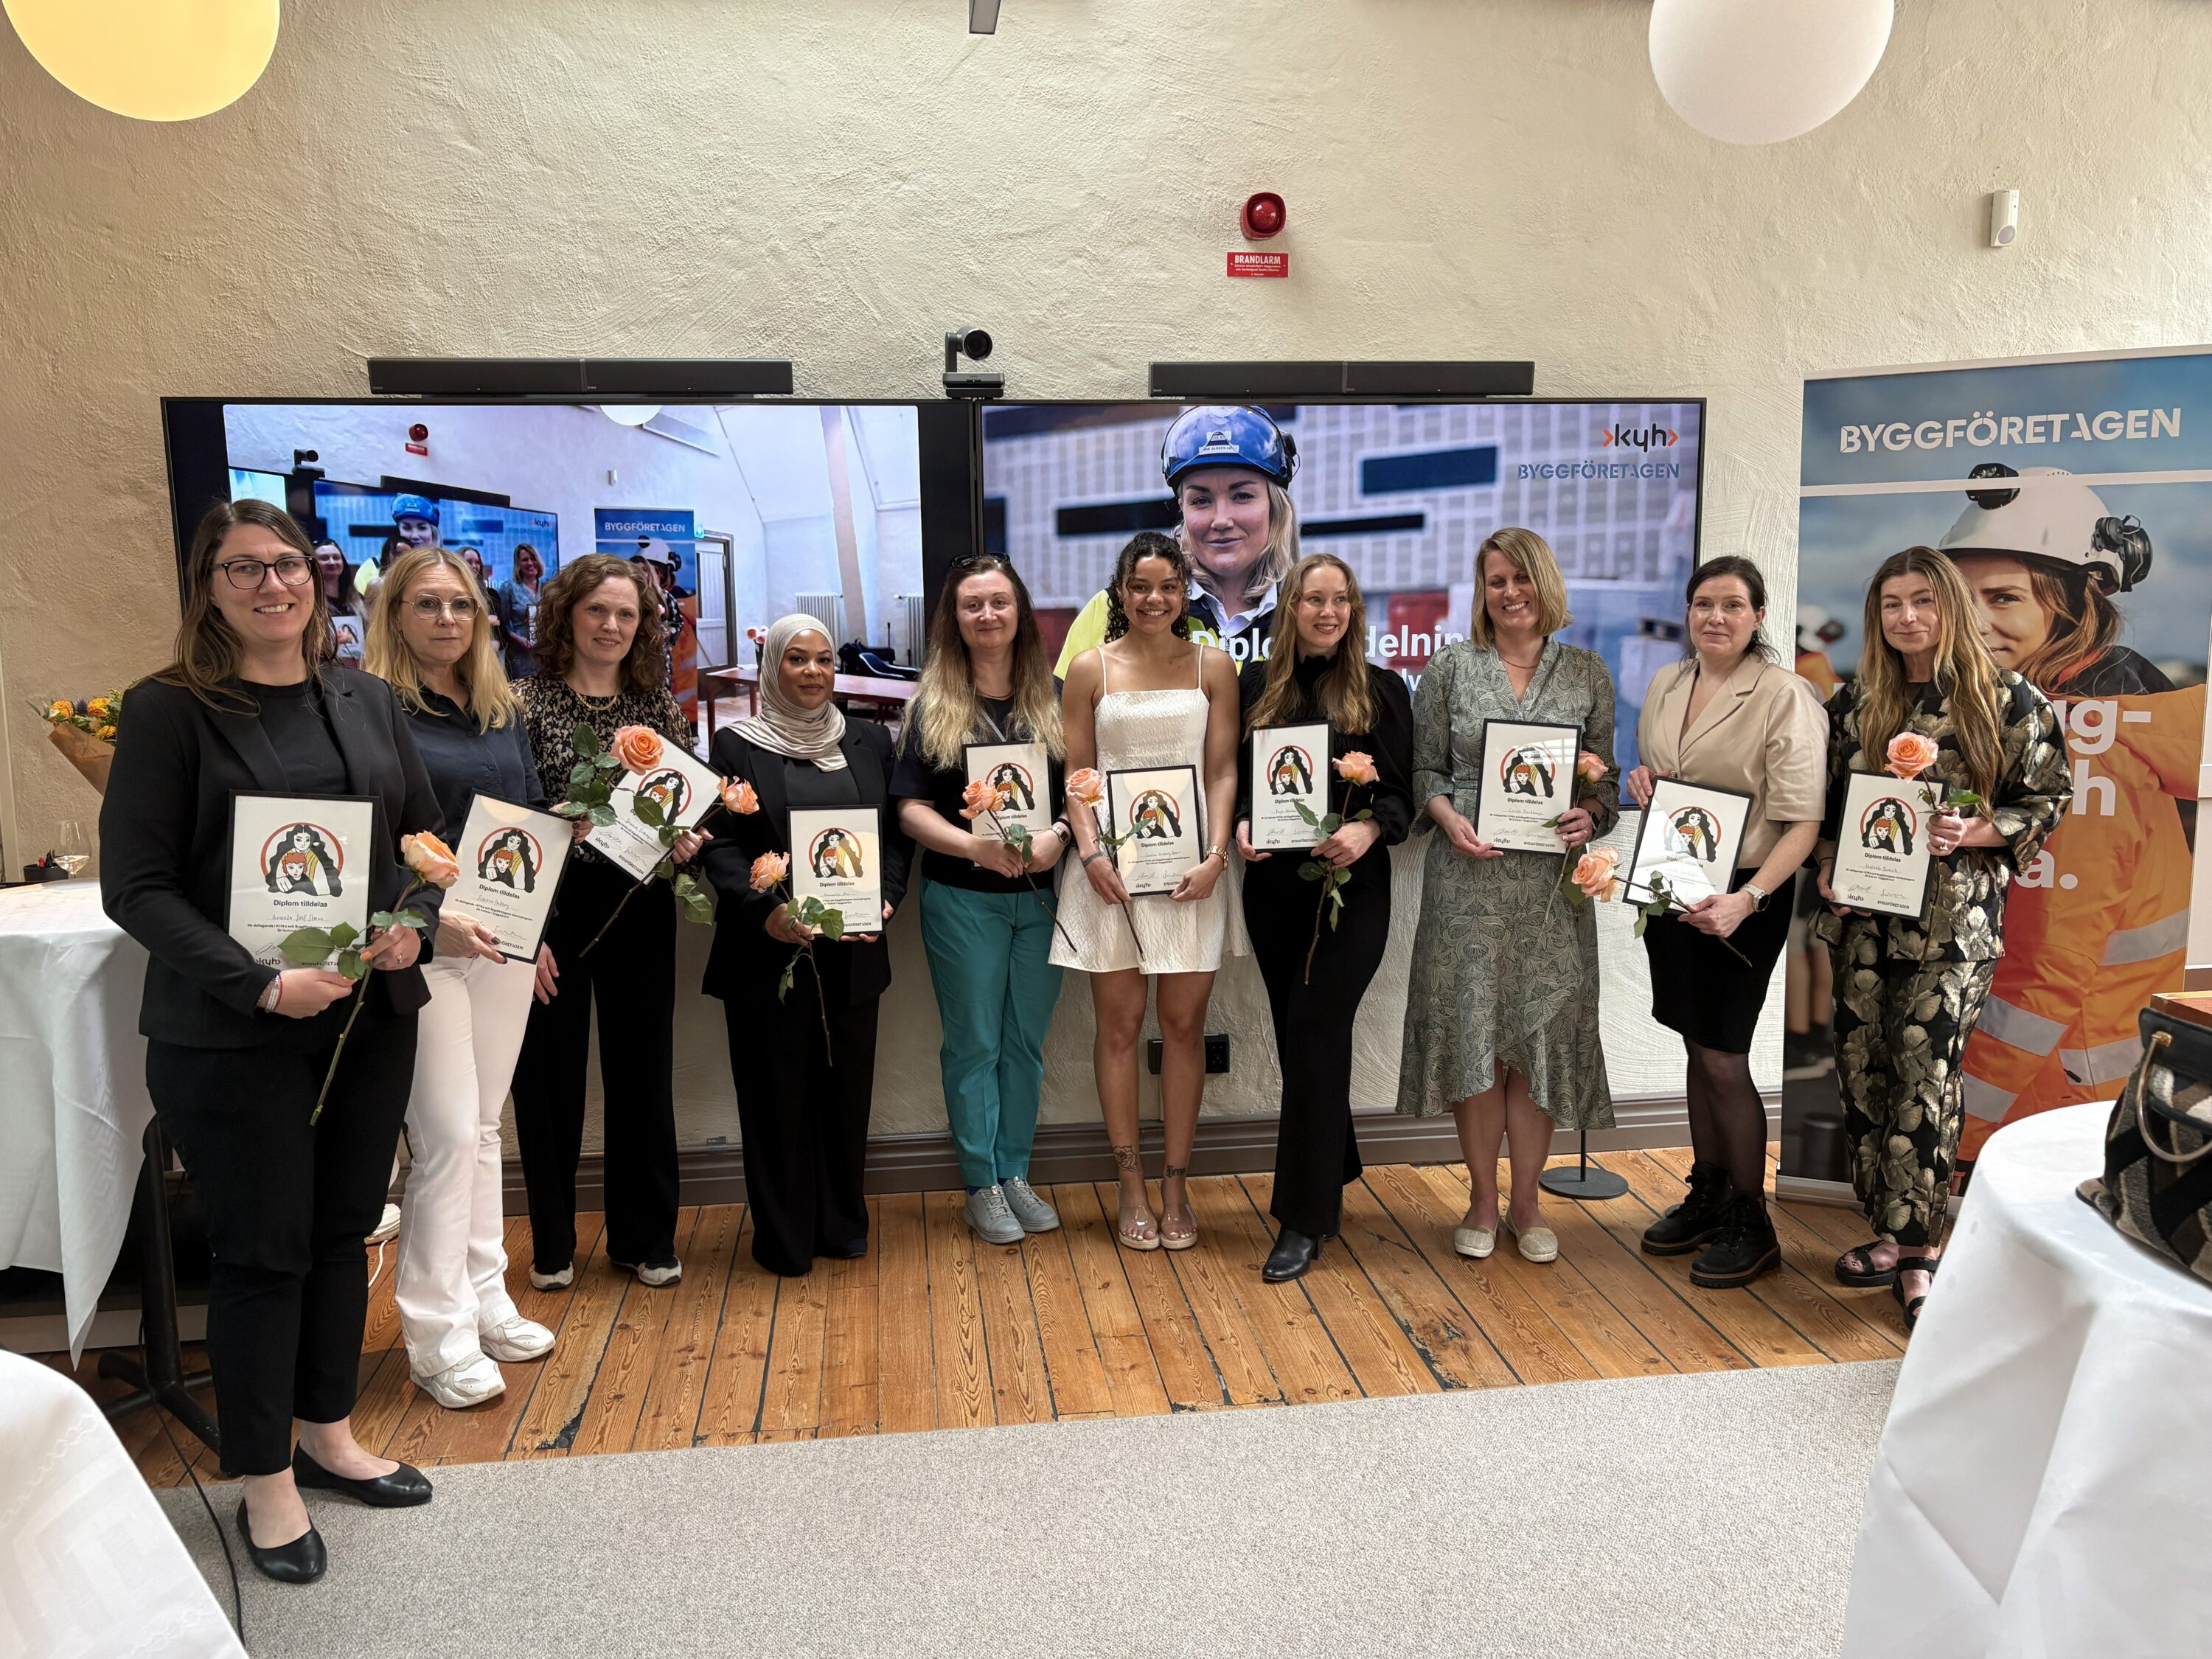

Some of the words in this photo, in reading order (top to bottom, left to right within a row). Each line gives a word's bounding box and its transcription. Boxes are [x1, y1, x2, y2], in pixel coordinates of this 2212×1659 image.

[1234, 254, 1281, 264] BRANDLARM
[1840, 408, 2181, 453] BYGGFÖRETAGEN
[1517, 460, 1680, 479] BYGGFÖRETAGEN
[605, 521, 686, 532] BYGGFÖRETAGEN
[479, 884, 499, 894] Diplom
[499, 889, 520, 900] tilldelas
